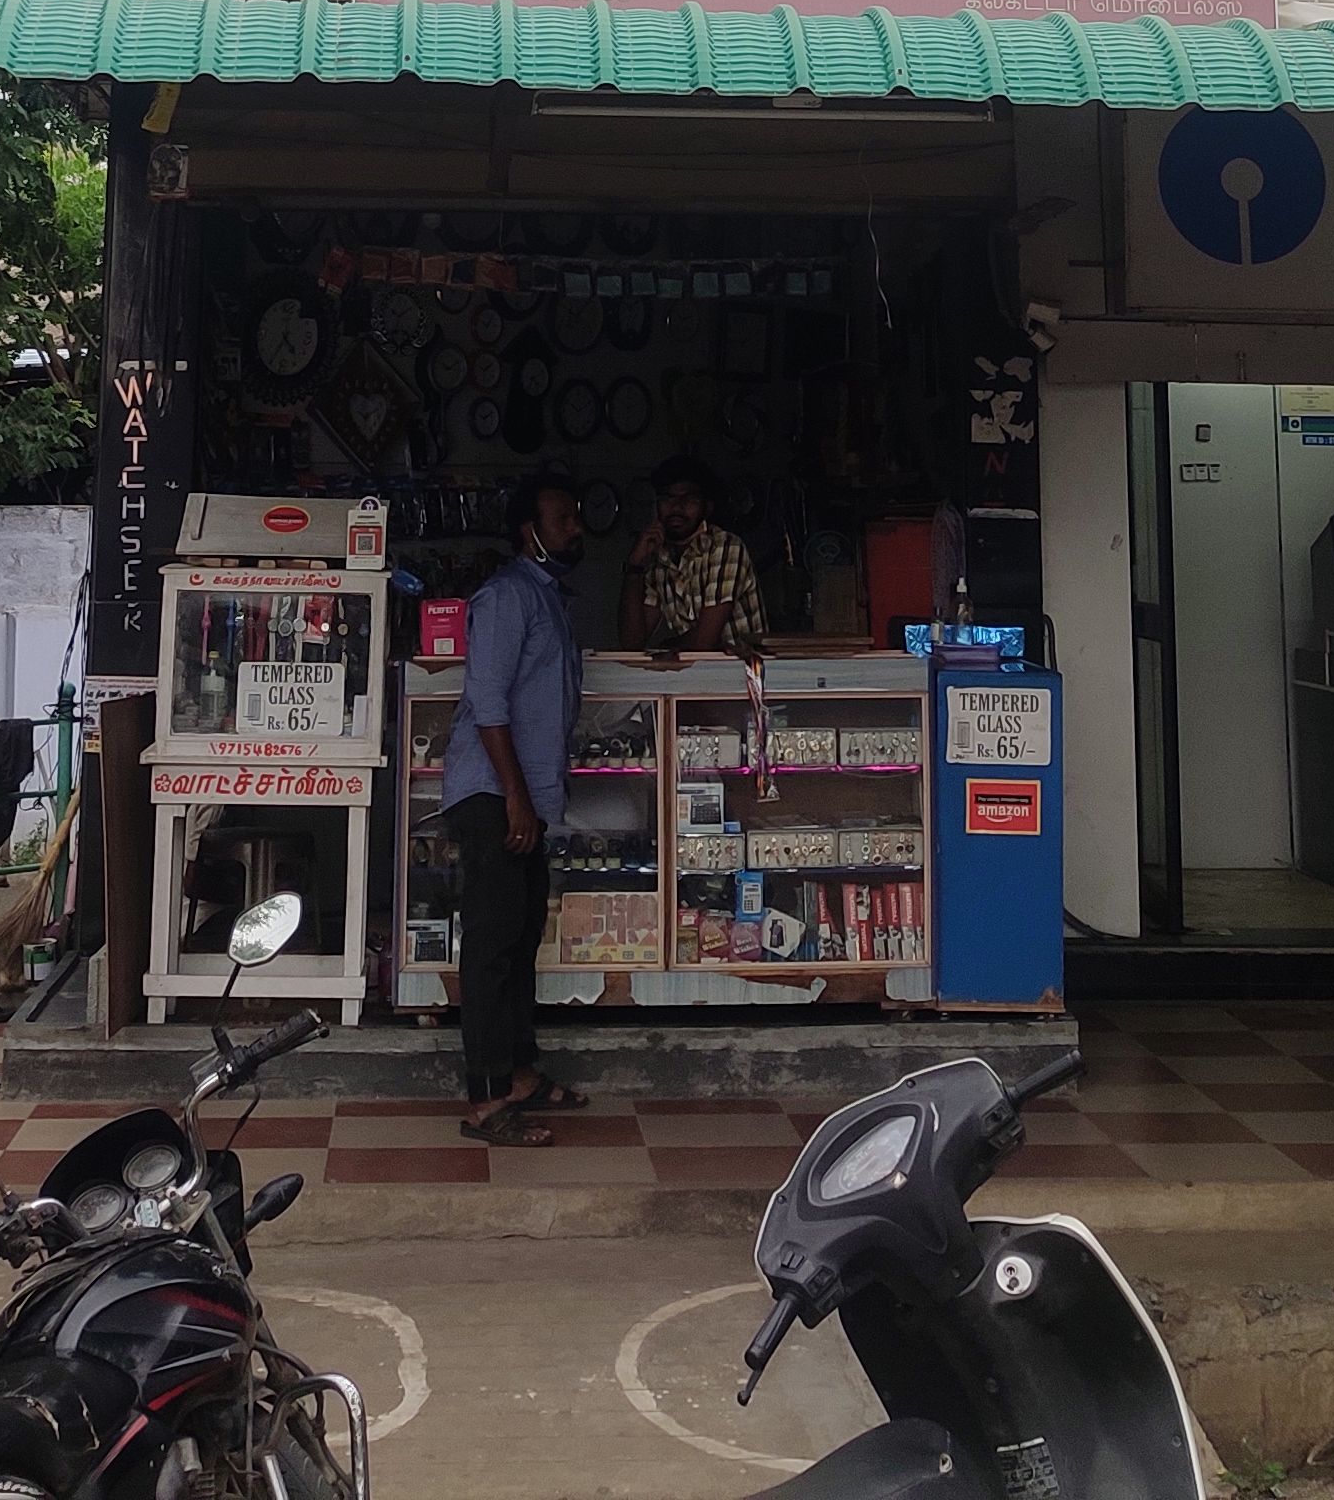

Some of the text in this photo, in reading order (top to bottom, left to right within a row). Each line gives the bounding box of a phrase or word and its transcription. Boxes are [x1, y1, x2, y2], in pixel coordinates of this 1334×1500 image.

[251, 664, 333, 684] TEMPERED
[268, 686, 315, 705] GLASS
[959, 693, 1039, 713] TEMPERED
[267, 707, 328, 731] Rs: 65/-
[977, 714, 1022, 733] GLASS
[977, 744, 994, 758] Rs:
[997, 736, 1036, 759] 65/-
[978, 805, 1029, 817] amazon
